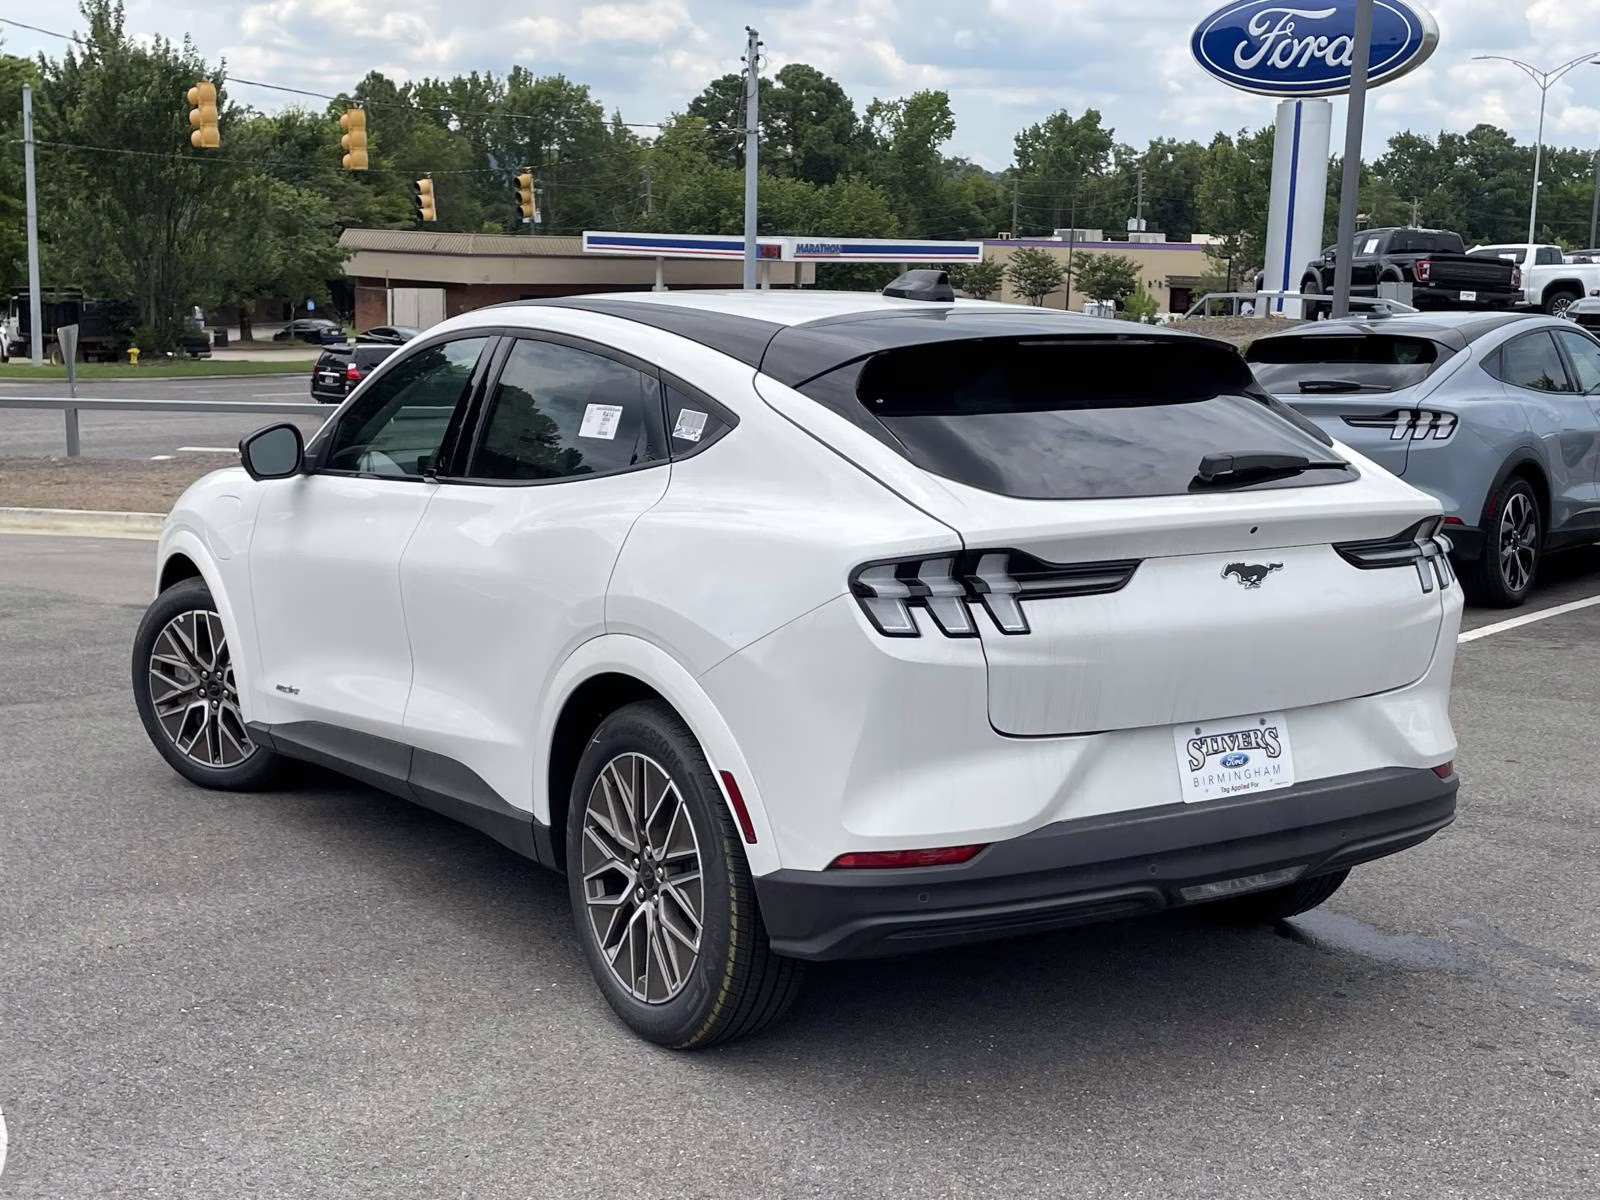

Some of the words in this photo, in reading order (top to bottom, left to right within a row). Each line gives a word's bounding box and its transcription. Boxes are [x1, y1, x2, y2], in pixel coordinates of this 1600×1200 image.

[796, 244, 840, 254] MARATHON
[1186, 727, 1281, 772] STIVERS
[1225, 756, 1244, 766] Ford
[1193, 764, 1281, 788] BIRMINGHAM
[1221, 786, 1230, 794] Tag
[1231, 782, 1250, 793] Applied
